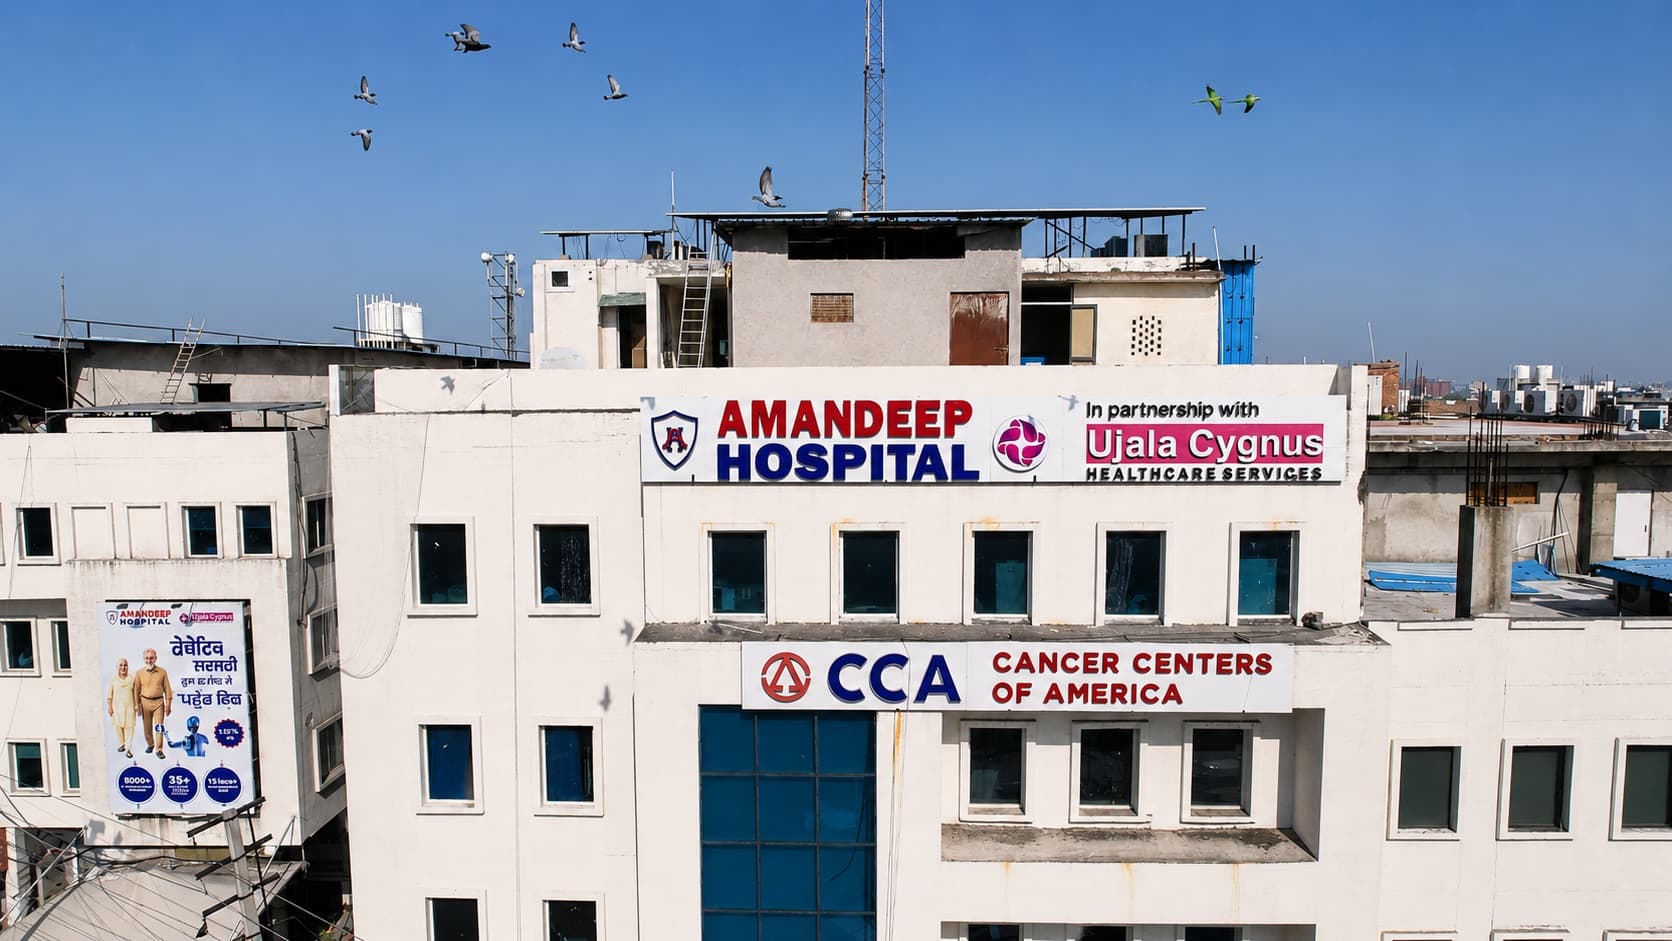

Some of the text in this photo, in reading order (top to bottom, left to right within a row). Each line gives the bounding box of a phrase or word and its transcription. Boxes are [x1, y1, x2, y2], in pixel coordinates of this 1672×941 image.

[717, 400, 973, 438] AMANDEEP
[1086, 401, 1259, 421] In partnership with
[1088, 428, 1324, 464] Ujala Cygnus
[717, 443, 980, 482] HOSPITAL
[1086, 467, 1322, 481] HEALTHCARE SERVICES
[992, 652, 1273, 675] CANCER CENTERS
[827, 653, 961, 704] CCA
[992, 682, 1183, 705] OF AMERICA
[168, 775, 190, 785] 35+
